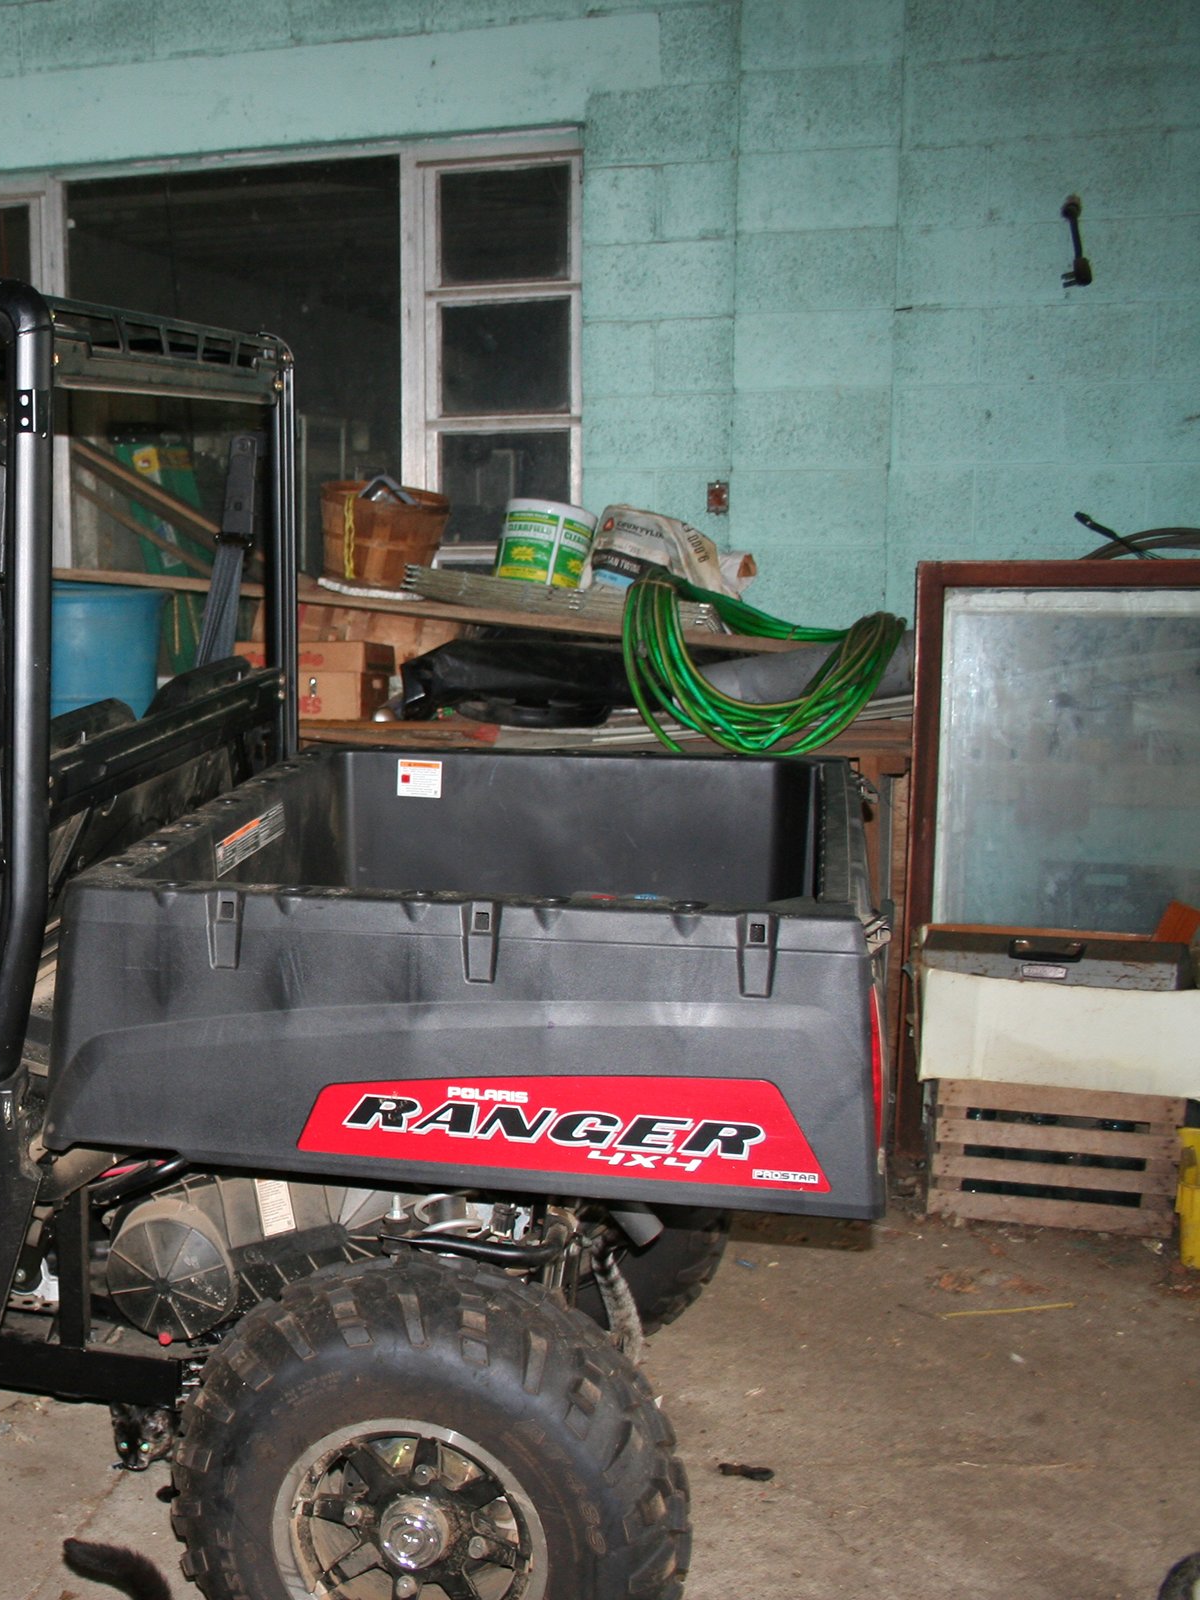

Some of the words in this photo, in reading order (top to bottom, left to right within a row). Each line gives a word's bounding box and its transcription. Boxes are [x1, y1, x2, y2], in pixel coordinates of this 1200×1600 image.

[447, 1086, 528, 1104] POLARIS
[342, 1094, 766, 1161] RANGER
[752, 1169, 818, 1184] PROSTAR
